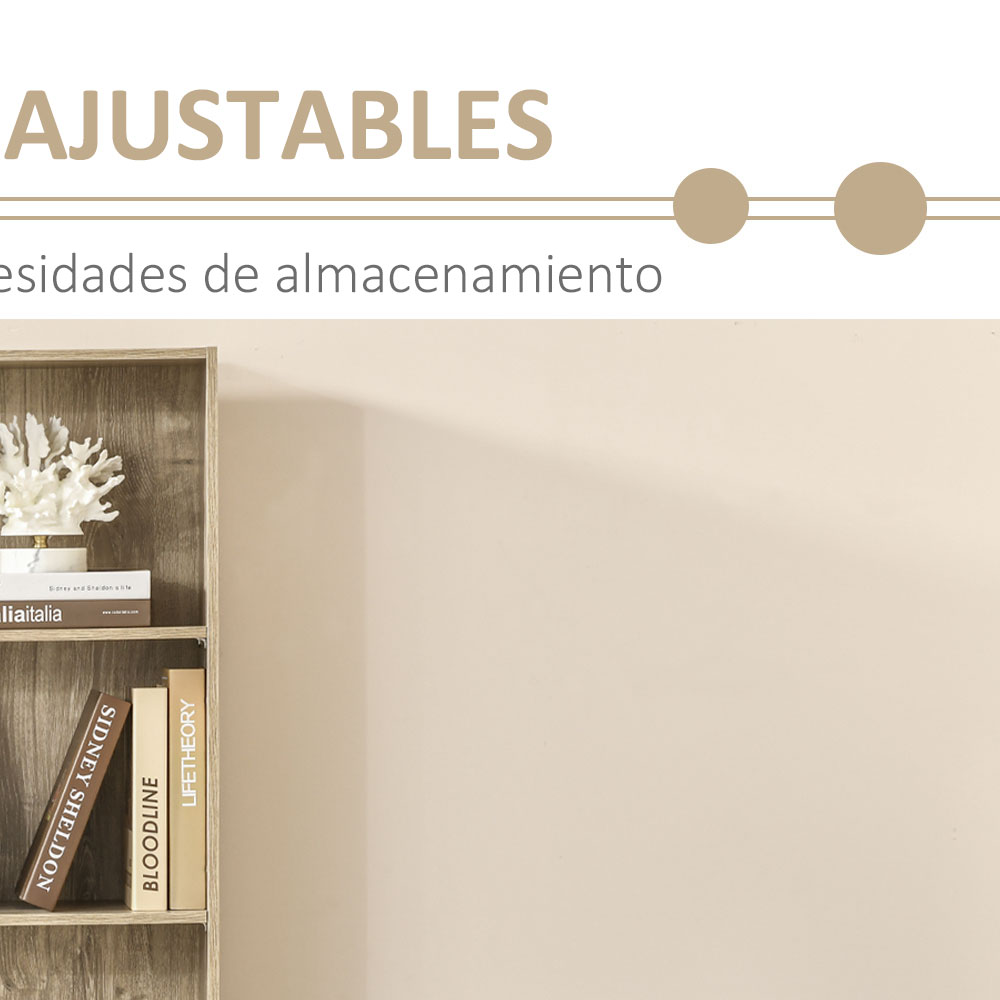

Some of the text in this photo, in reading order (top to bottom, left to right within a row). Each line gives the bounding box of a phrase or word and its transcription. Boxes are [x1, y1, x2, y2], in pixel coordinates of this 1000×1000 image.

[36, 704, 117, 892] SIDNEY SHELDON
[180, 698, 197, 807] LIFETHEORY
[142, 776, 159, 892] BLOODLINE
